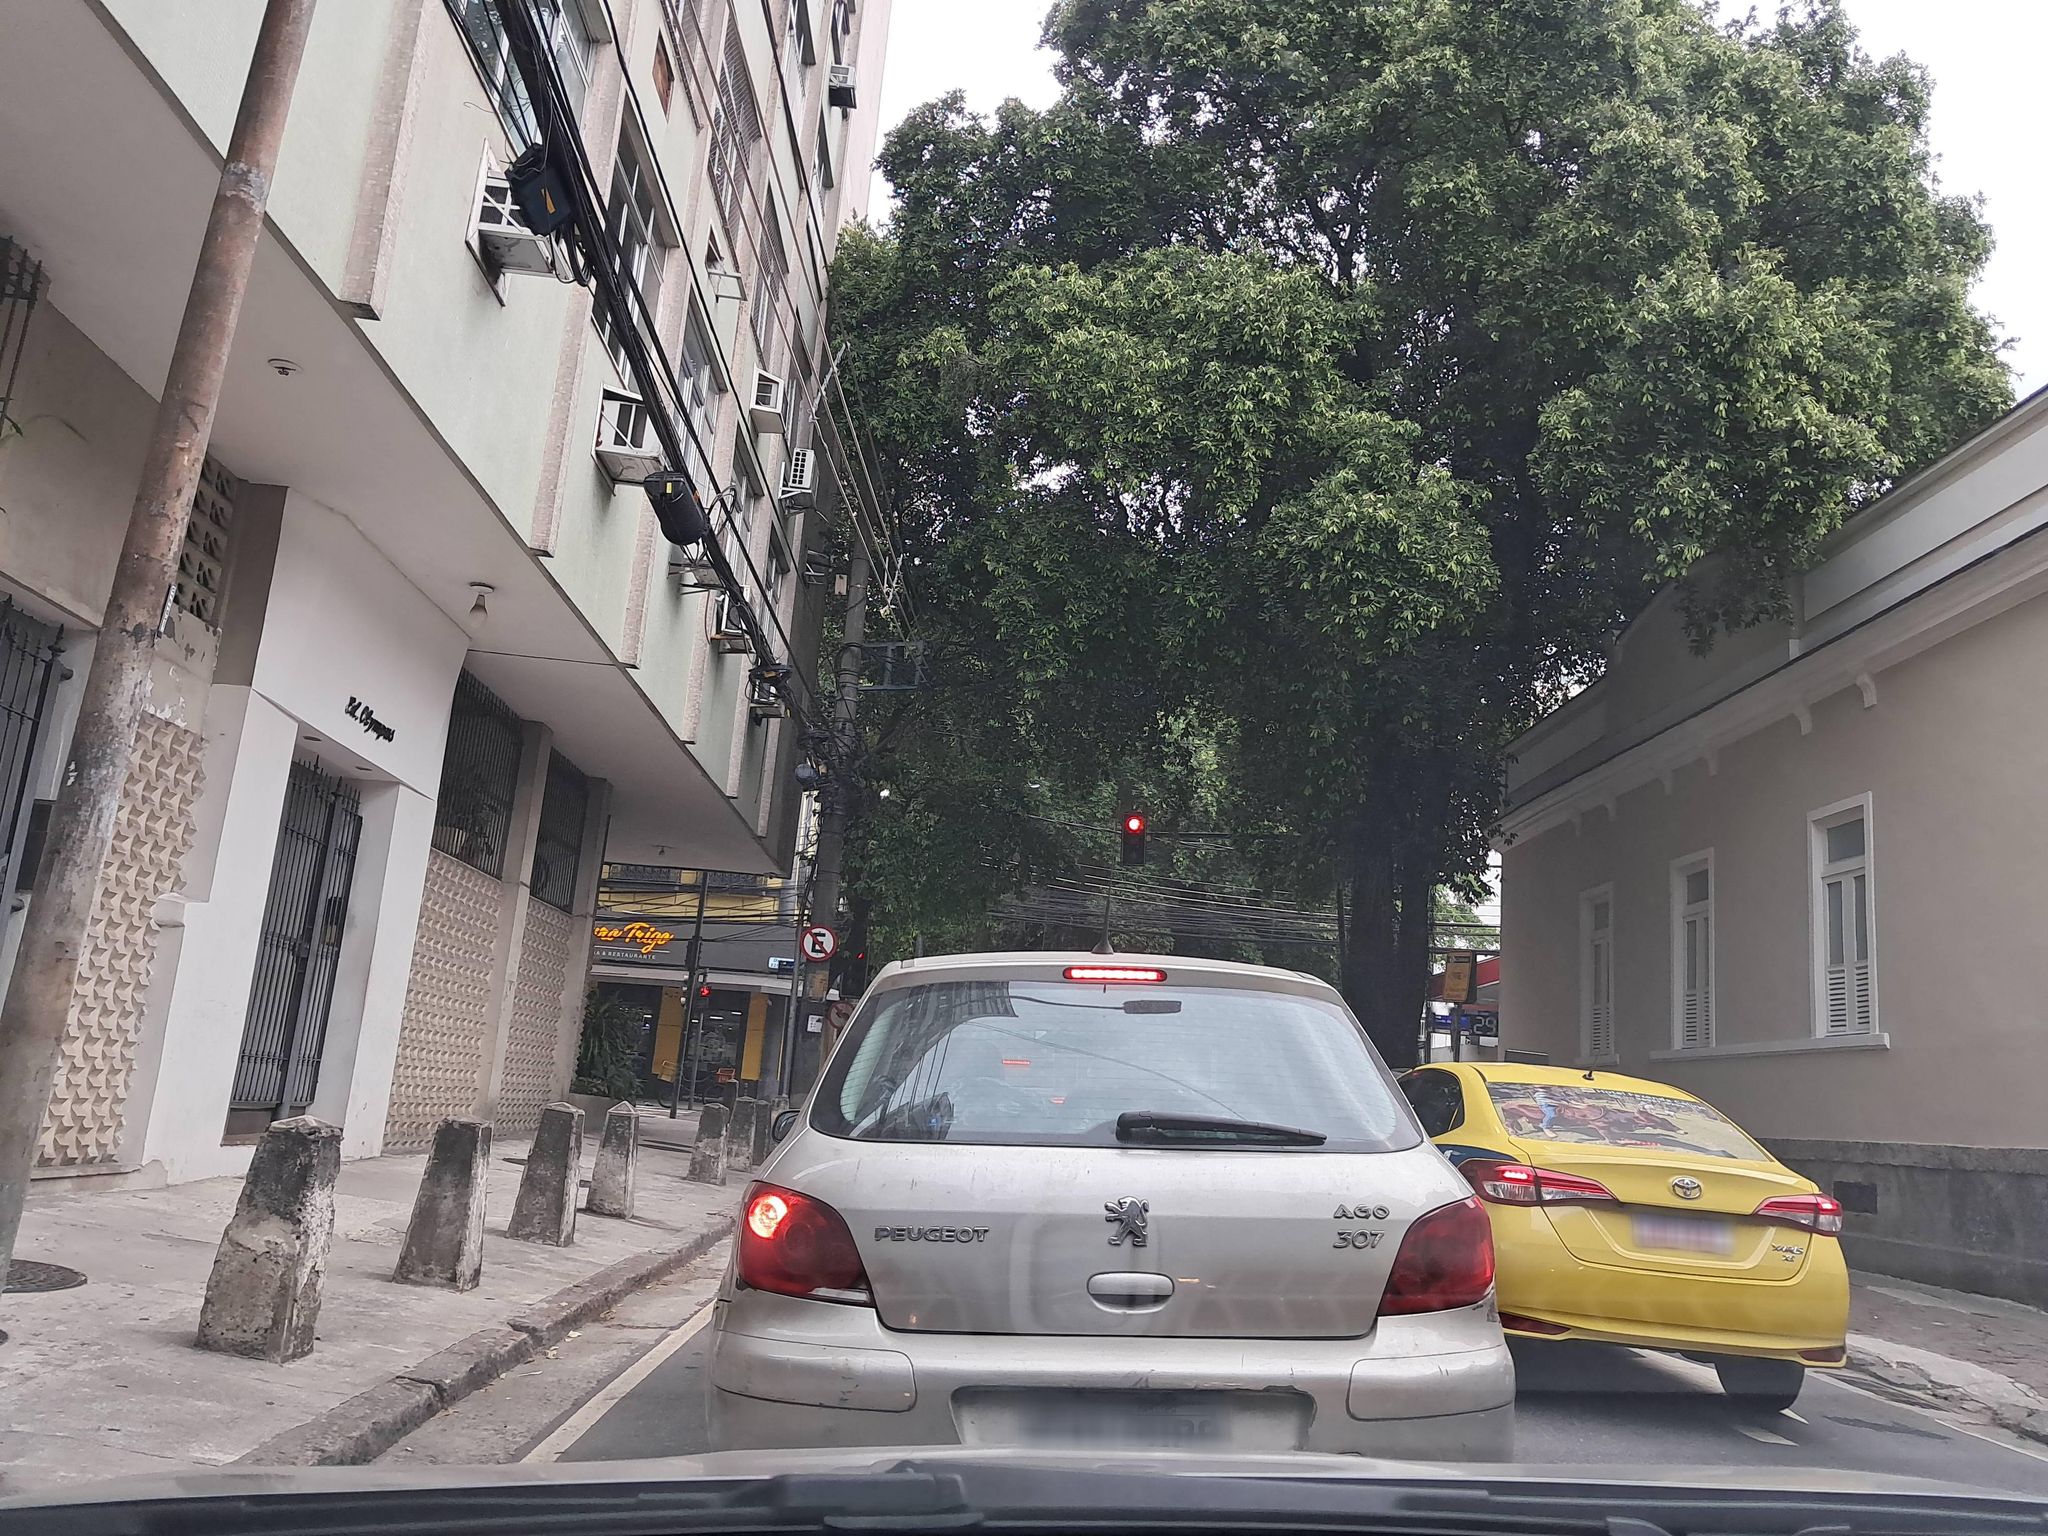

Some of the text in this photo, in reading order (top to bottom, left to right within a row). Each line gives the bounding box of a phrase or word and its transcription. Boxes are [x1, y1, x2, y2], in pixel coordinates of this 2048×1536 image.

[624, 922, 675, 953] Trigo
[811, 932, 827, 954] E
[608, 951, 656, 960] RESTAURANTE
[1474, 1016, 1498, 1036] 29
[1333, 1203, 1390, 1220] AGO
[874, 1226, 989, 1243] PEUGEOT
[1332, 1229, 1385, 1249] 307
[1771, 1243, 1804, 1255] YARIS
